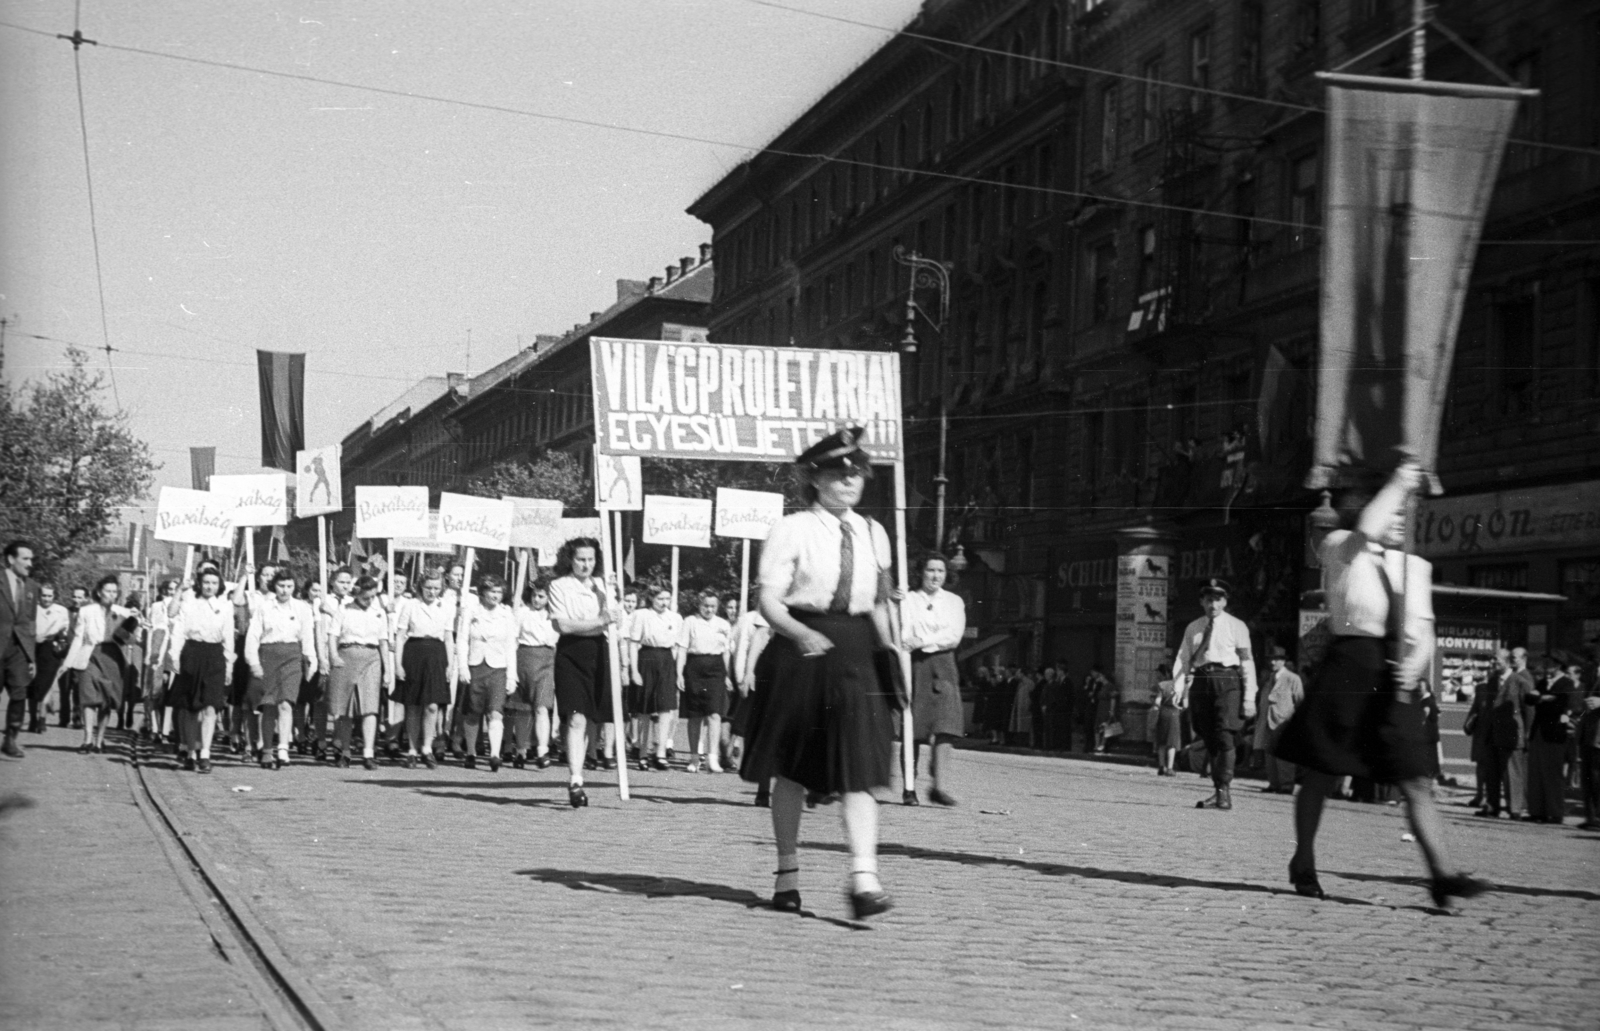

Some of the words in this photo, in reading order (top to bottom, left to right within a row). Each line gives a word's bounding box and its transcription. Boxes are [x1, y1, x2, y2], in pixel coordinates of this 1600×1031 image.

[608, 411, 896, 458] EGYESÜLJETE!!!
[159, 504, 232, 540] Barátság
[235, 488, 283, 516] rátság
[1057, 558, 1117, 588] SCHILL
[1179, 540, 1234, 579] BÉLA
